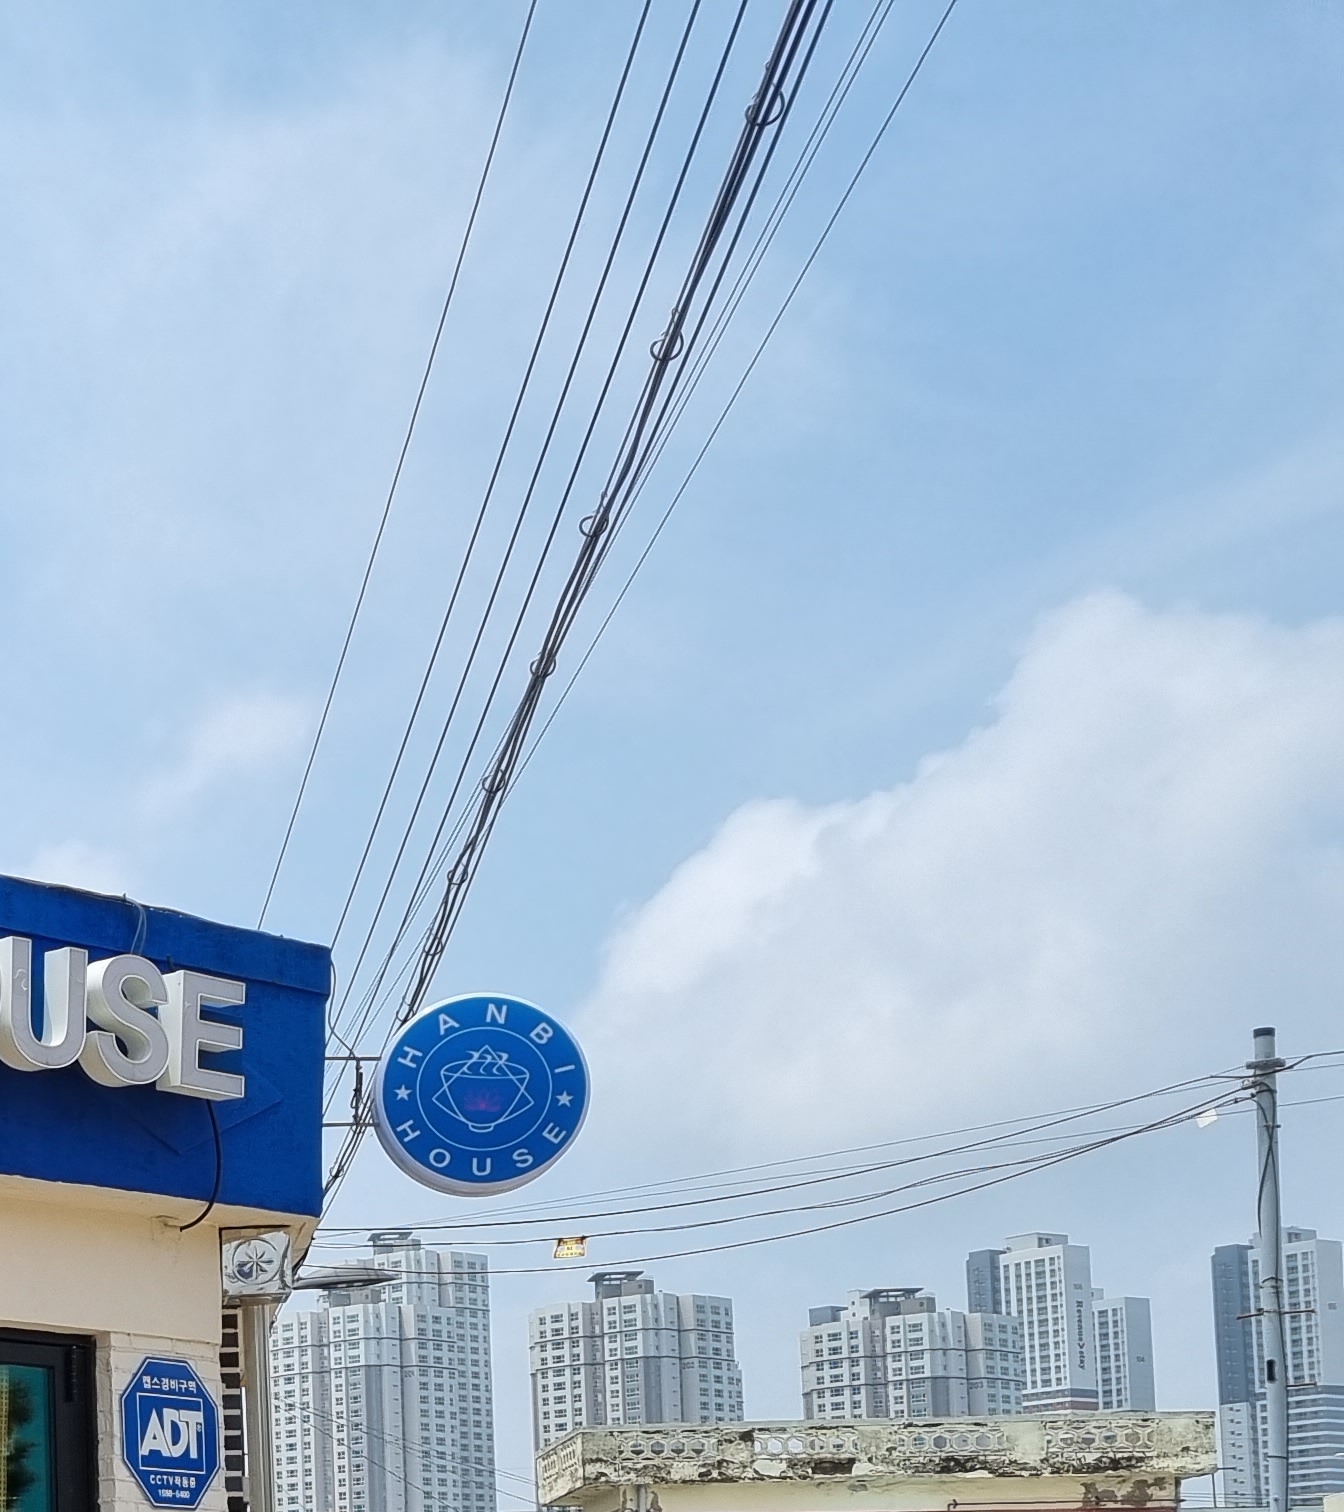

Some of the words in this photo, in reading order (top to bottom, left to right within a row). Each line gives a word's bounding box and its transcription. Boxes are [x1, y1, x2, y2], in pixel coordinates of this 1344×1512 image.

[397, 1003, 575, 1073] HANBI
[396, 1119, 567, 1176] HOUSE
[140, 1407, 203, 1459] ADT
